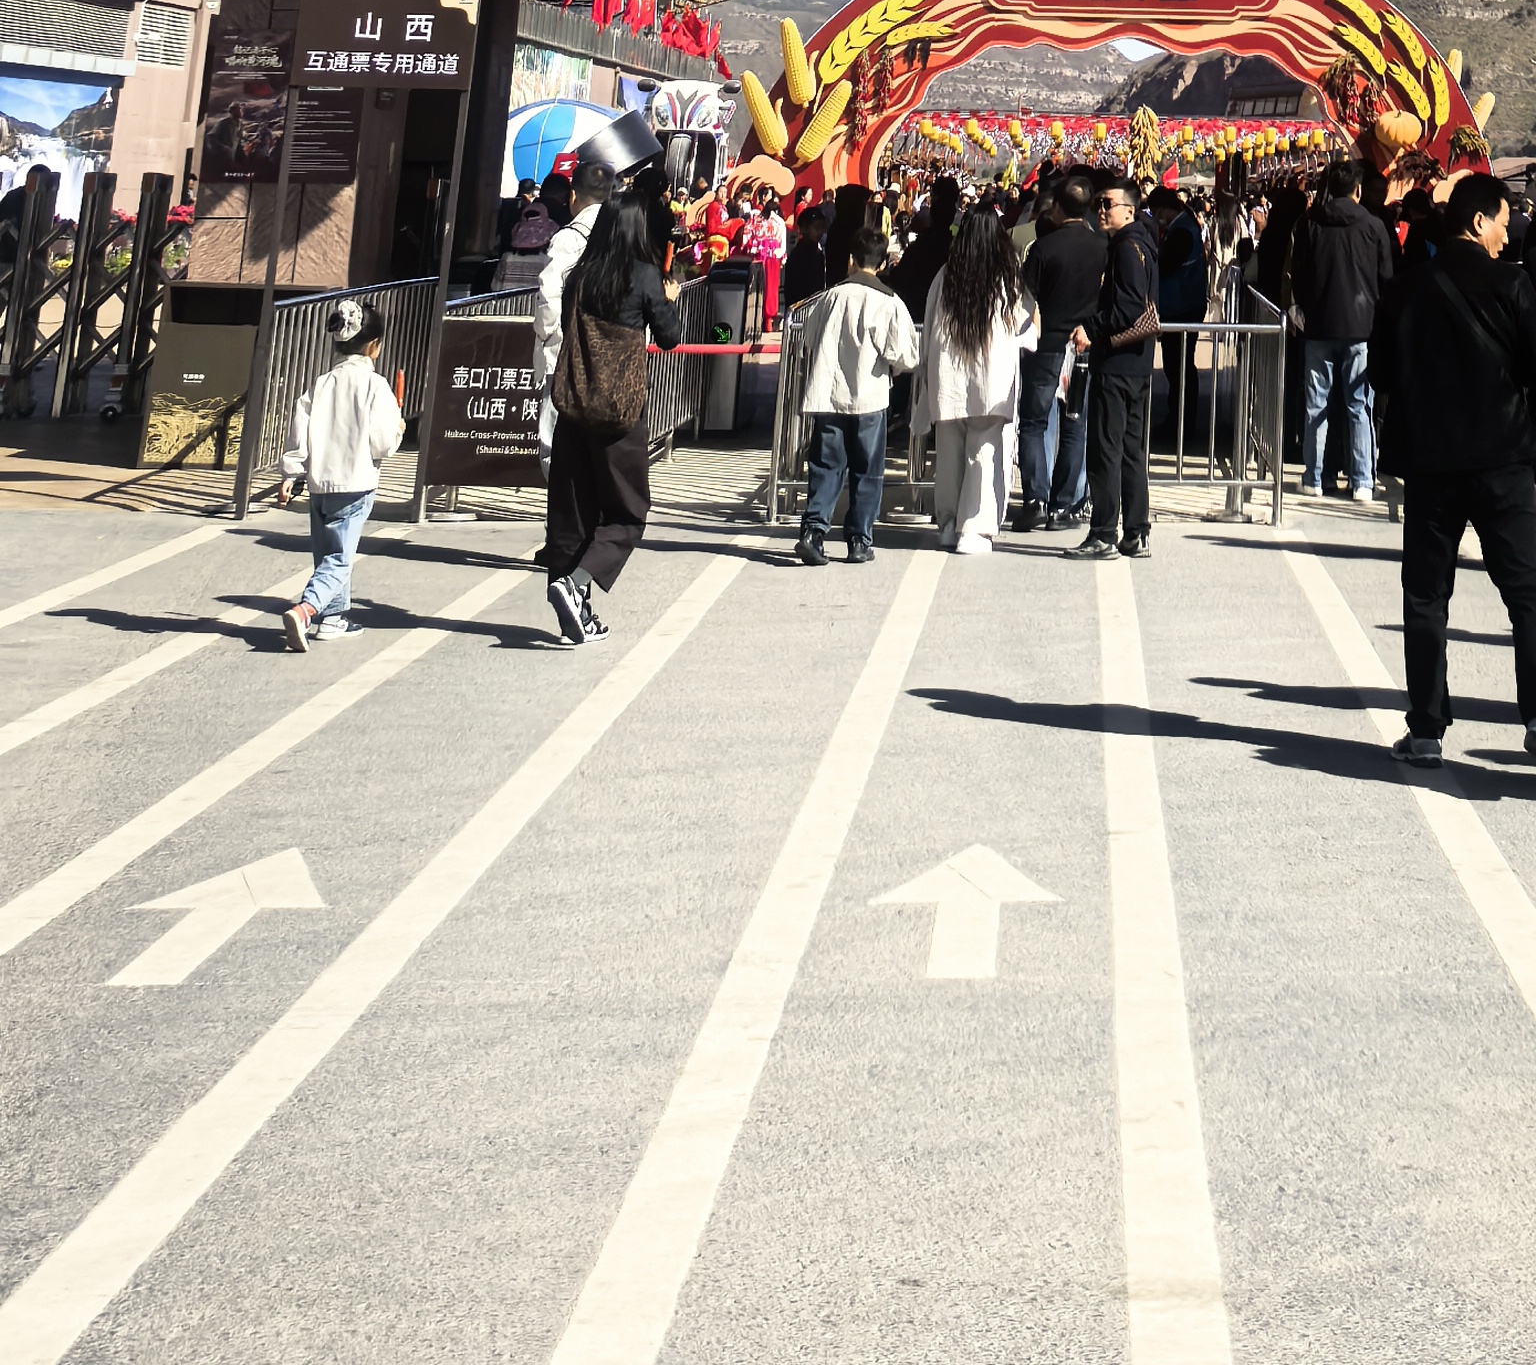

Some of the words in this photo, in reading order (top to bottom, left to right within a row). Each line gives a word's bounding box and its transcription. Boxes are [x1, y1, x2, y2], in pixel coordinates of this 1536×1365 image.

[354, 11, 436, 42] 山西
[303, 50, 461, 76] 互通票专用通道
